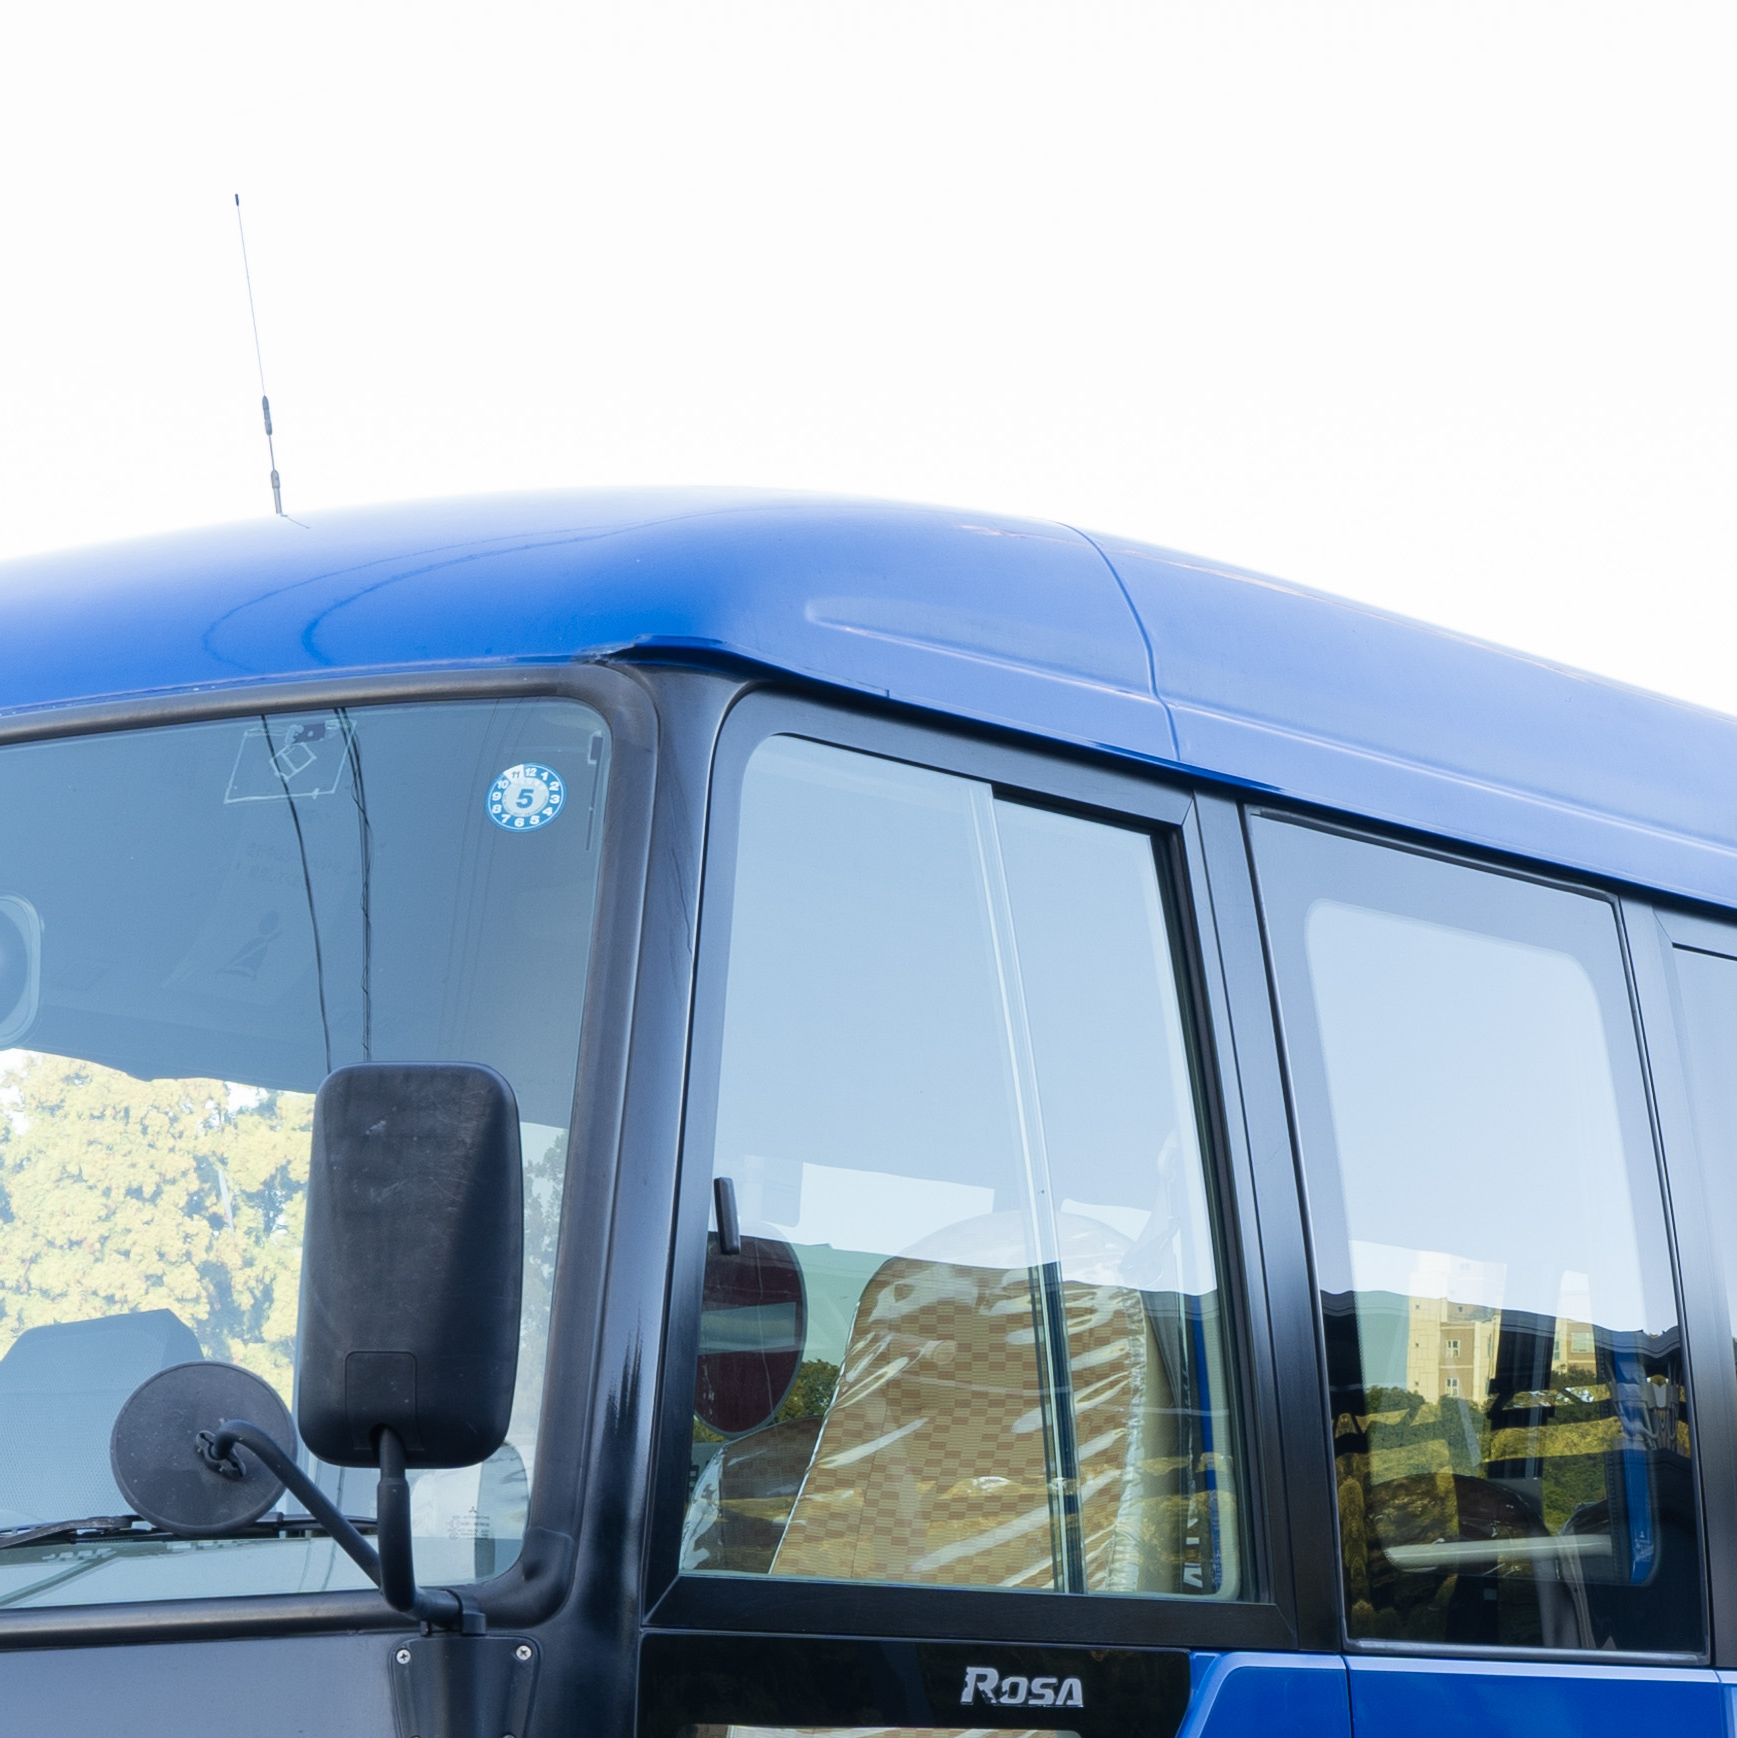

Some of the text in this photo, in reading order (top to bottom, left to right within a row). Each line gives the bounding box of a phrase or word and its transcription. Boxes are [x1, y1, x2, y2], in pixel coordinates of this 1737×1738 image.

[492, 767, 561, 827] 11 12 1 2 3 4 5 6 7 8 9 10
[516, 788, 535, 809] 5
